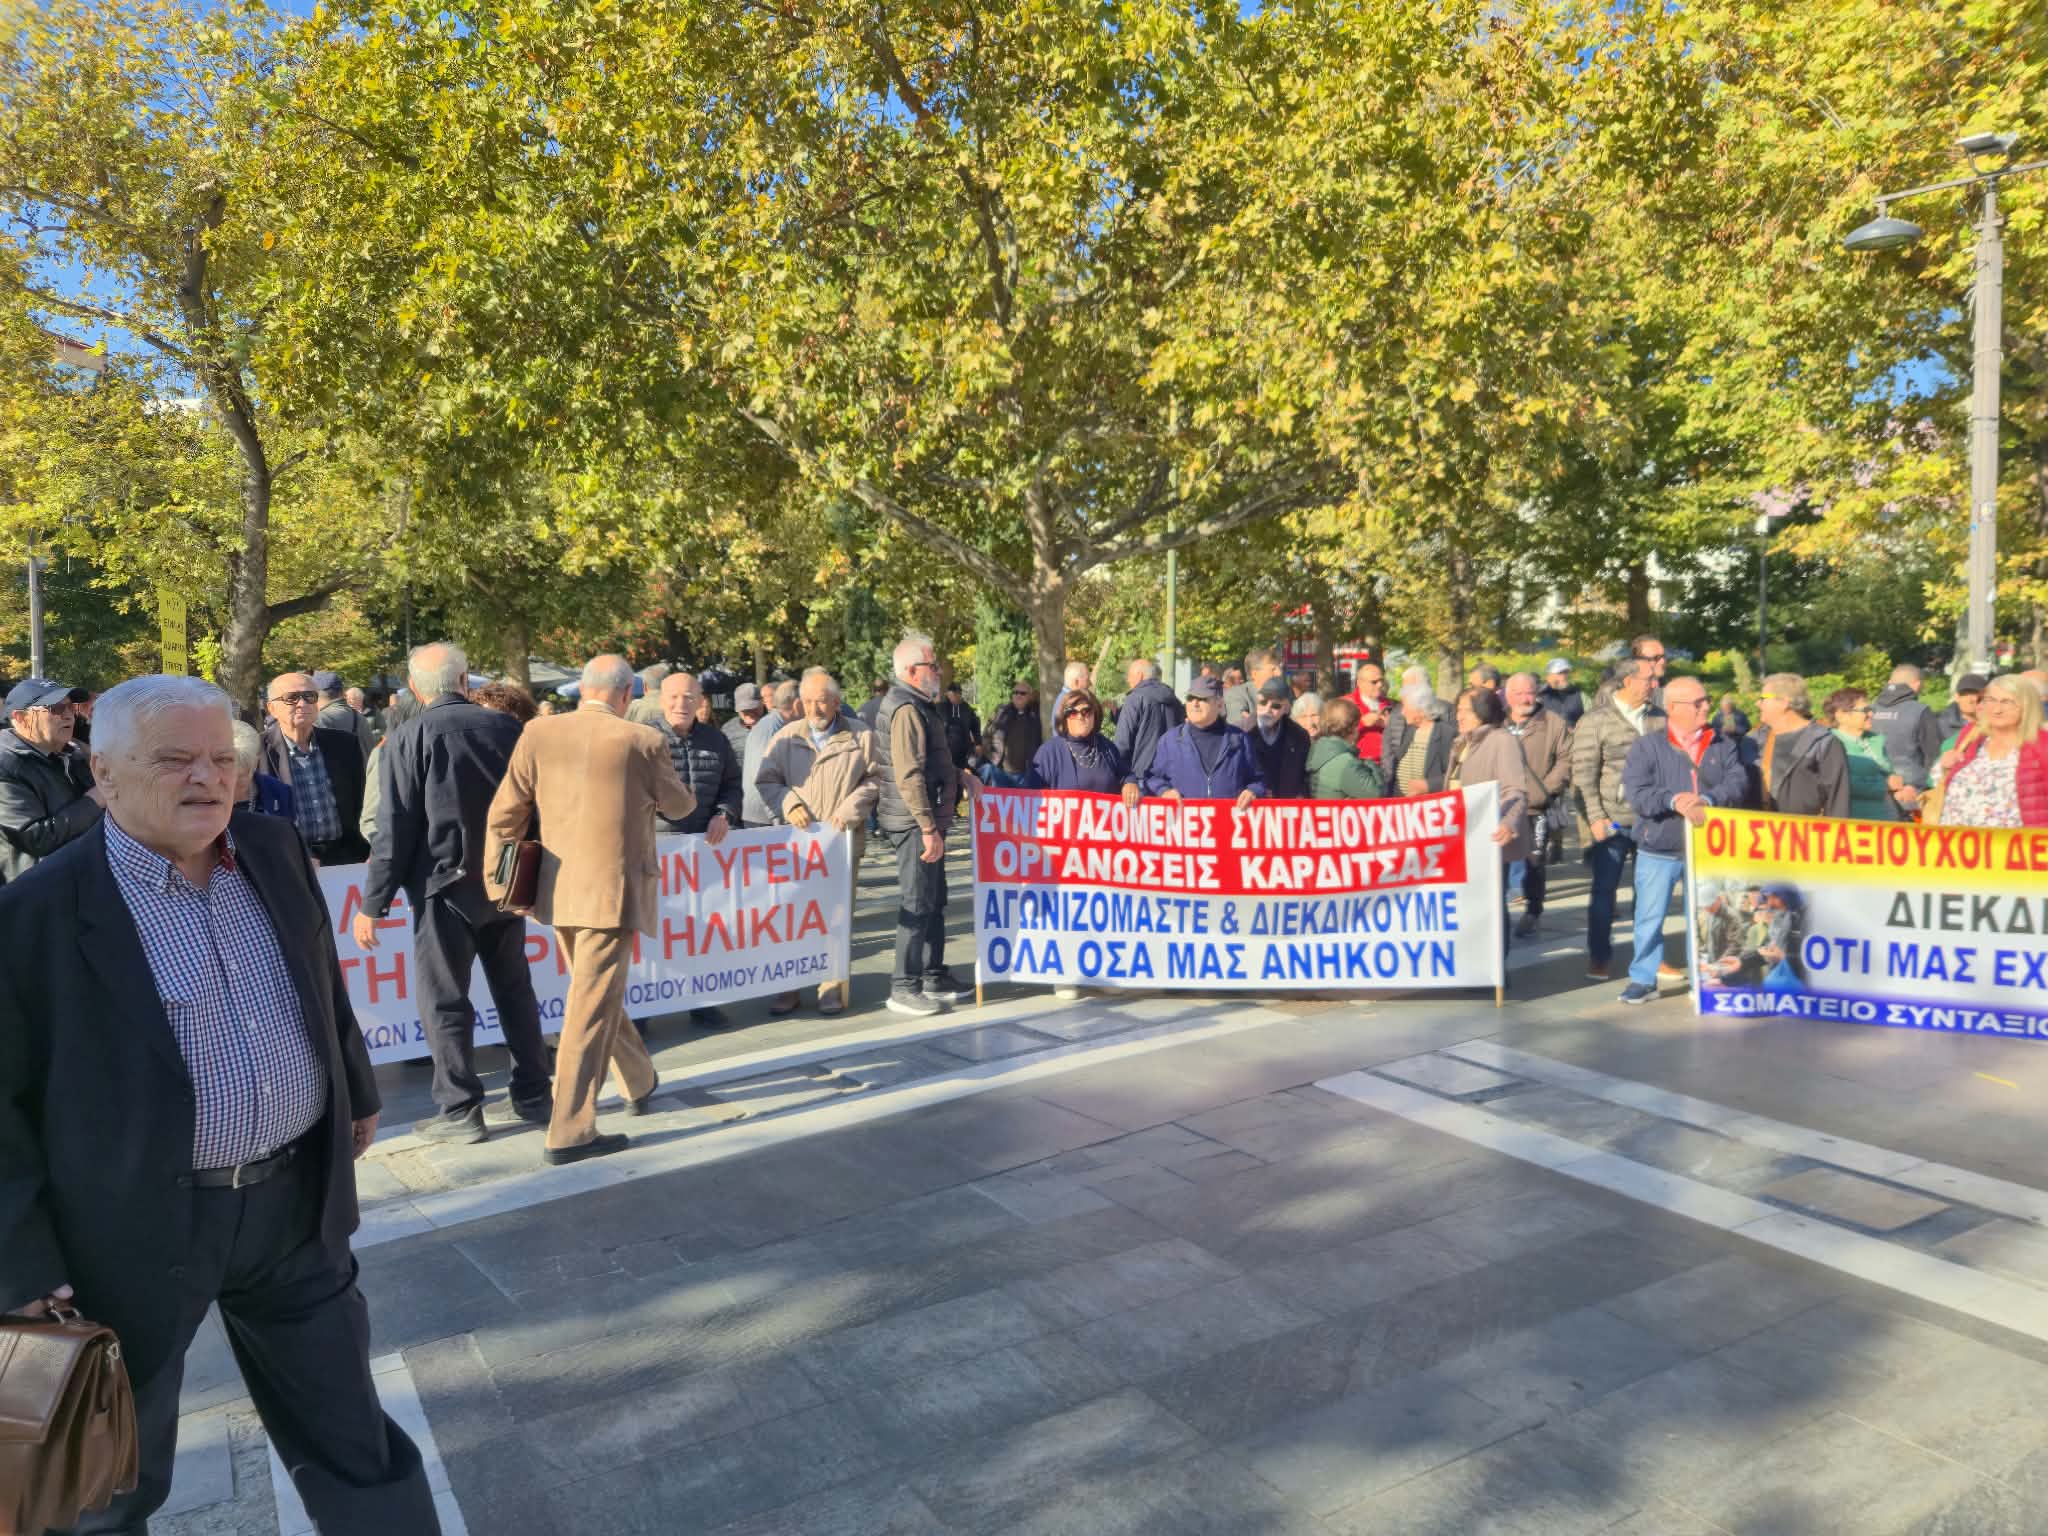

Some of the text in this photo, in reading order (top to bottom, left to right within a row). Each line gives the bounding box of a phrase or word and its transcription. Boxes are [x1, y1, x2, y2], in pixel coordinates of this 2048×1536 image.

[980, 793, 1459, 849] ΣΥΝΕΡΓΑΖΟΜΕΝΕΣ ΣΥΝΤΑΞΙΟΥΧΙΚΕΣ
[1706, 818, 1736, 857] ΟΙ
[1748, 819, 1991, 869] ΣΥΝΤΑΞΙΟΥΧΟΙ
[713, 839, 829, 890] ΥΓΕΙΑ
[994, 840, 1446, 889] ΟΡΓΑΝΩΣΕΙΣ ΚΑΡΔΙΤΣΑΣ
[663, 898, 829, 961] ΗΛΙΚΙΑ
[984, 889, 1459, 936] ΑΓΩΝΙΖΟΜΑΣΤΕ & ΔΙΕΚΔΙΚΟΥΜΕ
[692, 965, 756, 996] ΝΟΜΟΥ
[761, 952, 829, 983] ΛΑΡΙΣΑΣ
[987, 936, 1456, 981] ΟΛΑ ΟΣΑ ΜΑΣ ΑΝΗΚΟΥΝ
[1805, 935, 1871, 975] ΟΤΙ
[1888, 942, 1977, 984] ΜΑΣ
[1713, 992, 1877, 1021] ΣΩΜΑΤΕΙΟ
